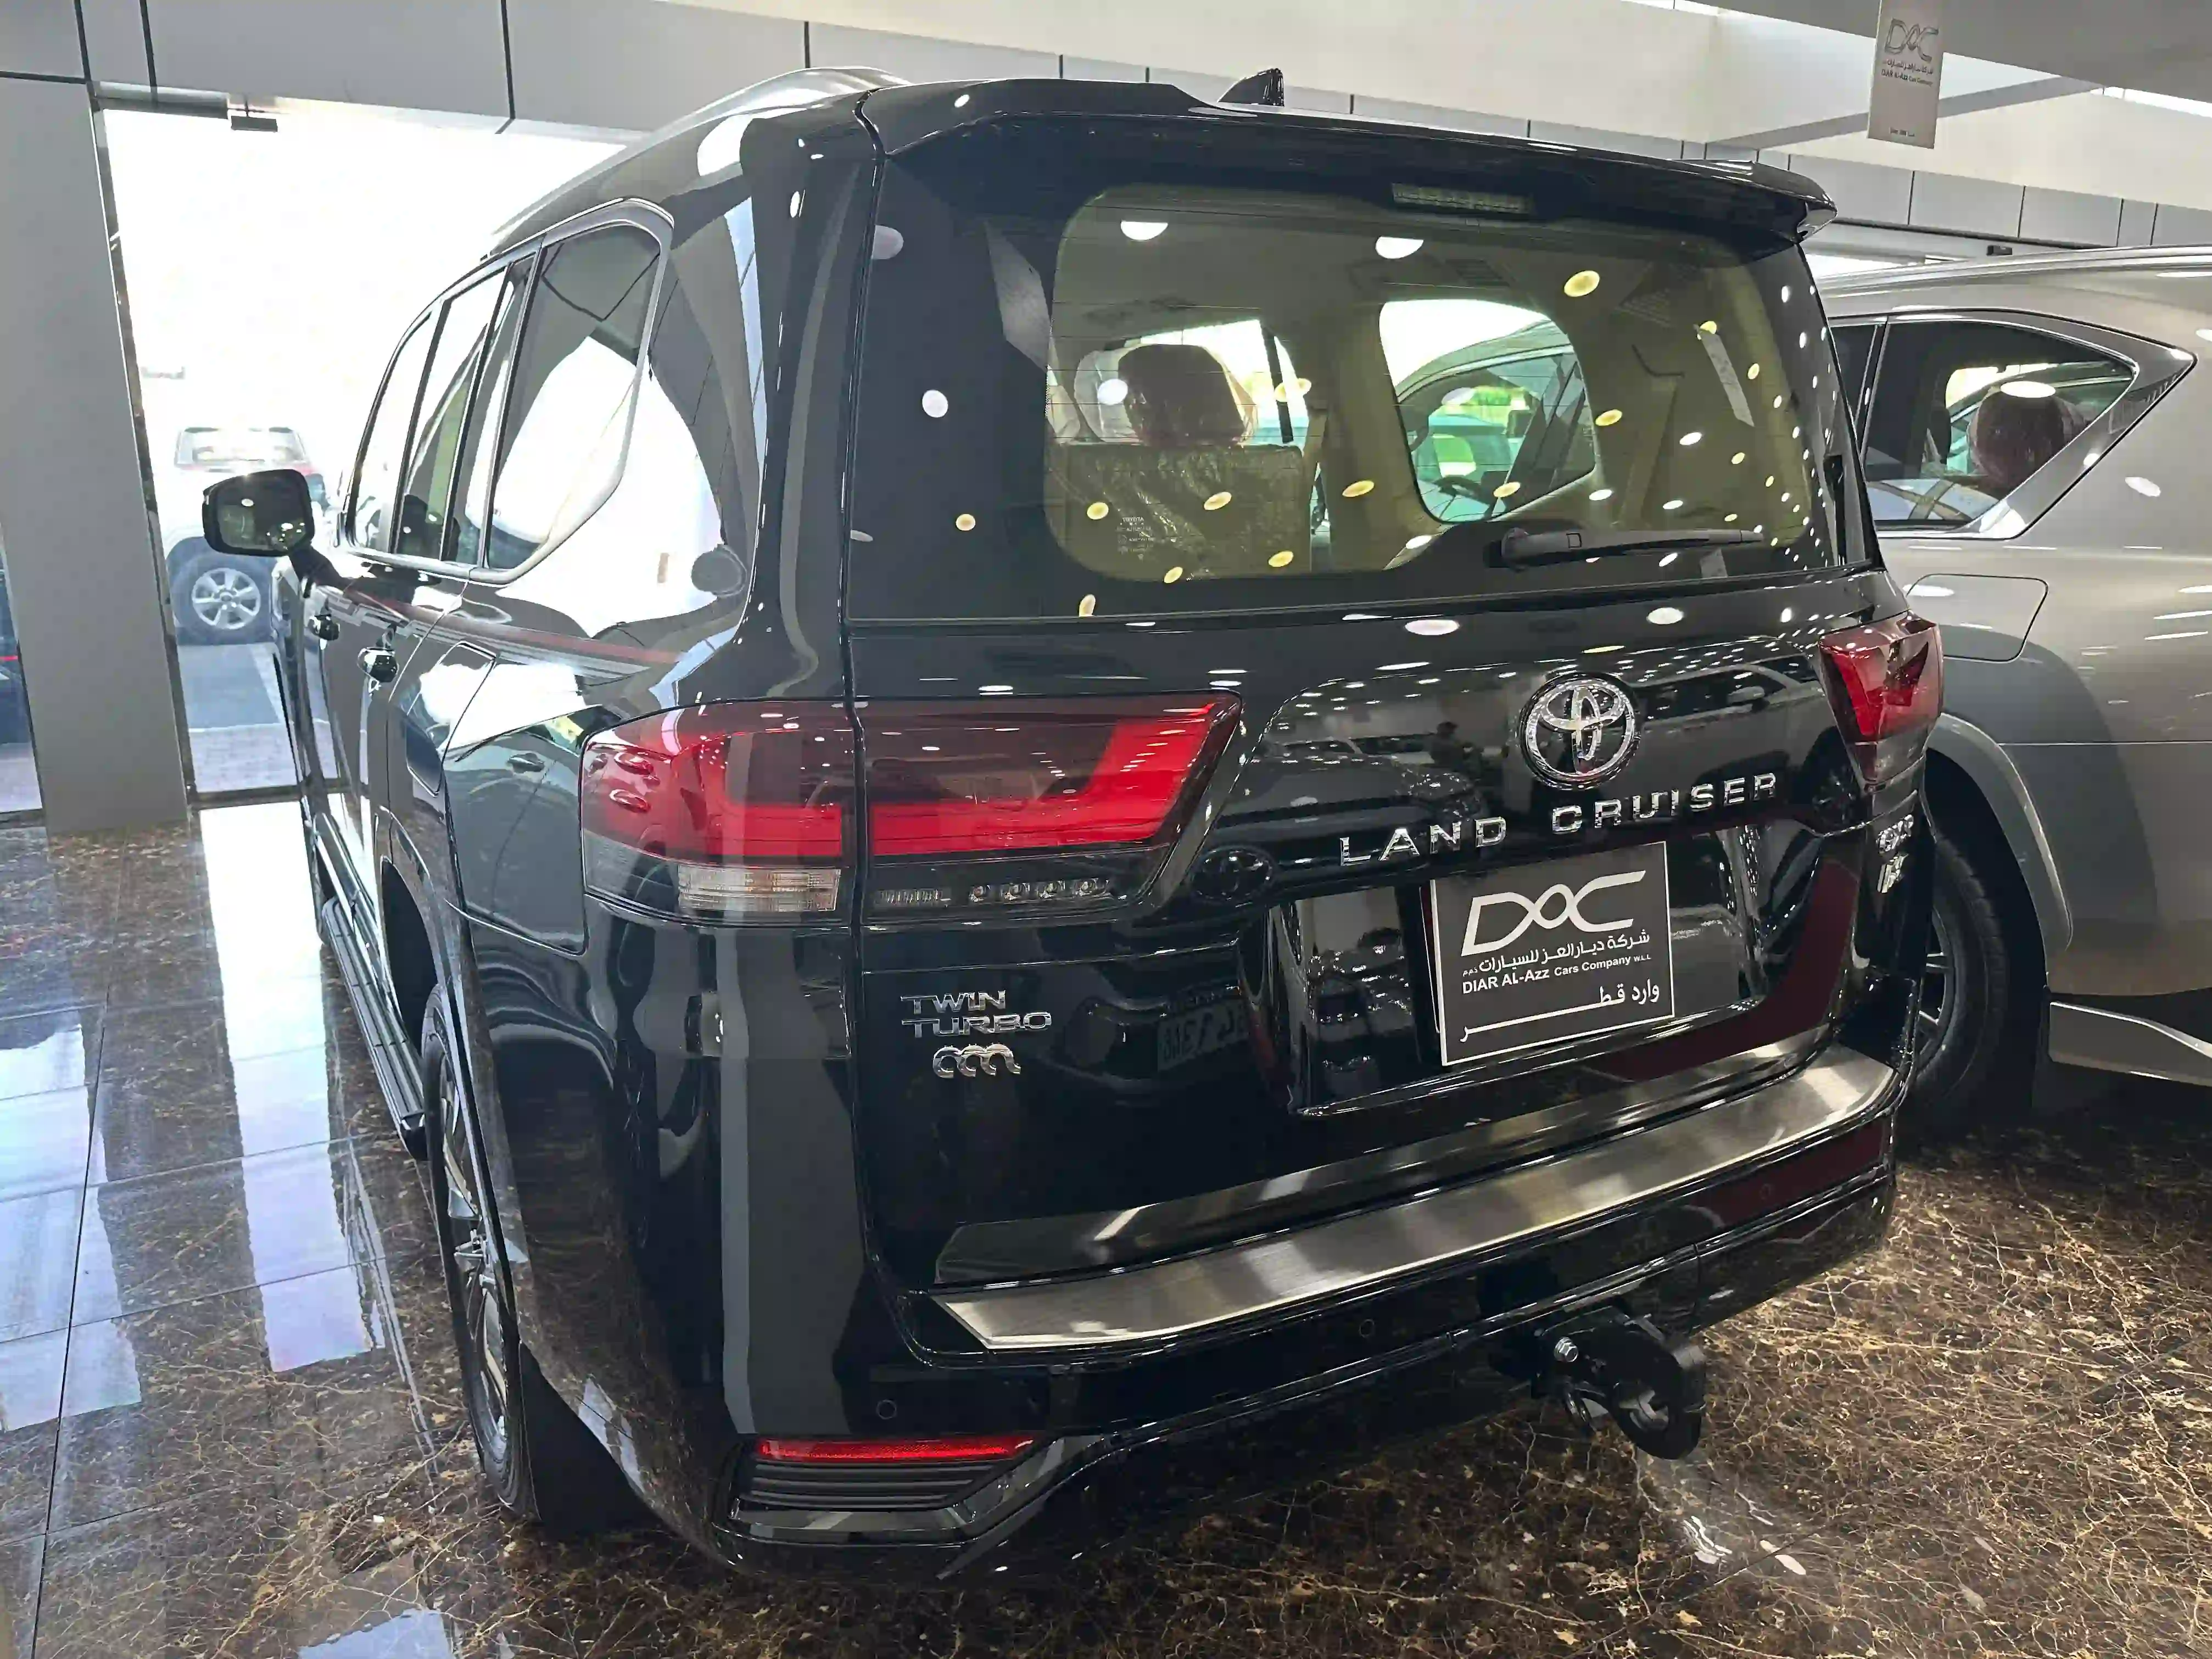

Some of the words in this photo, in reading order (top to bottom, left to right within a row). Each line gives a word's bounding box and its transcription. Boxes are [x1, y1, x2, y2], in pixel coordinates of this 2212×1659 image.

[1340, 817, 1506, 866] LAND
[1552, 773, 1777, 834] CRUISER
[1607, 929, 1650, 949] شركة
[1479, 949, 1539, 973] للسيارات
[1462, 976, 1499, 994] DIAR
[1554, 965, 1579, 976] Cars
[1582, 956, 1631, 971] Company
[900, 990, 1006, 1015] TWIN
[1632, 978, 1660, 1005] وارد
[901, 1011, 1052, 1038] TURBO
